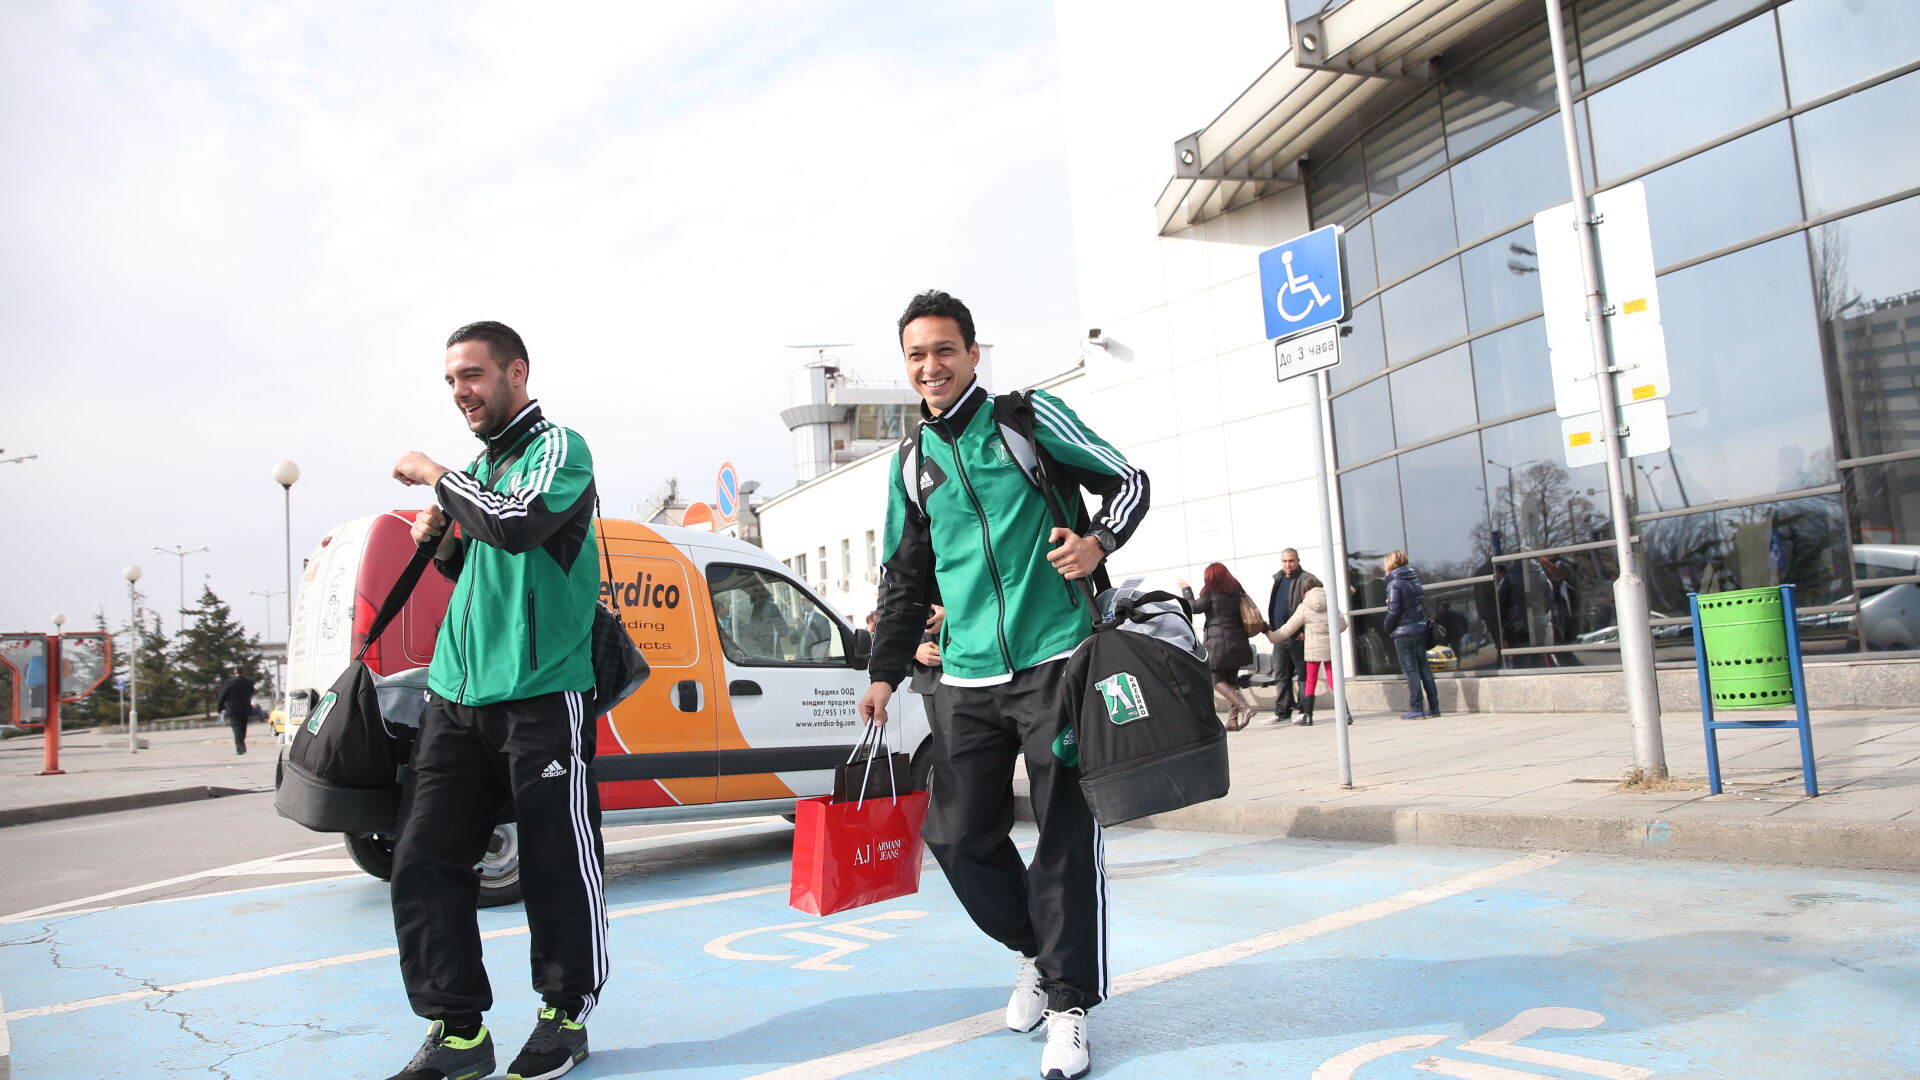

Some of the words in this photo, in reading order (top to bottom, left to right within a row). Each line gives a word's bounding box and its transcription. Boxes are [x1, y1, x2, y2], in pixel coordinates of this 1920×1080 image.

[1280, 353, 1292, 368] До
[1298, 346, 1304, 360] 3
[1309, 341, 1334, 355] часа
[599, 571, 680, 609] erdico
[814, 687, 840, 697] Вердико
[840, 687, 855, 696] ООД
[801, 699, 827, 707] вендинг
[827, 699, 856, 708] продукти
[813, 708, 837, 718] 02/955
[838, 708, 847, 716] 19
[848, 708, 856, 716] 19
[795, 719, 856, 729] www.verdico-bg.com
[541, 769, 567, 777] adidas
[876, 839, 901, 852] ARMANI
[854, 844, 870, 865] AJ
[879, 849, 900, 861] JEANS
